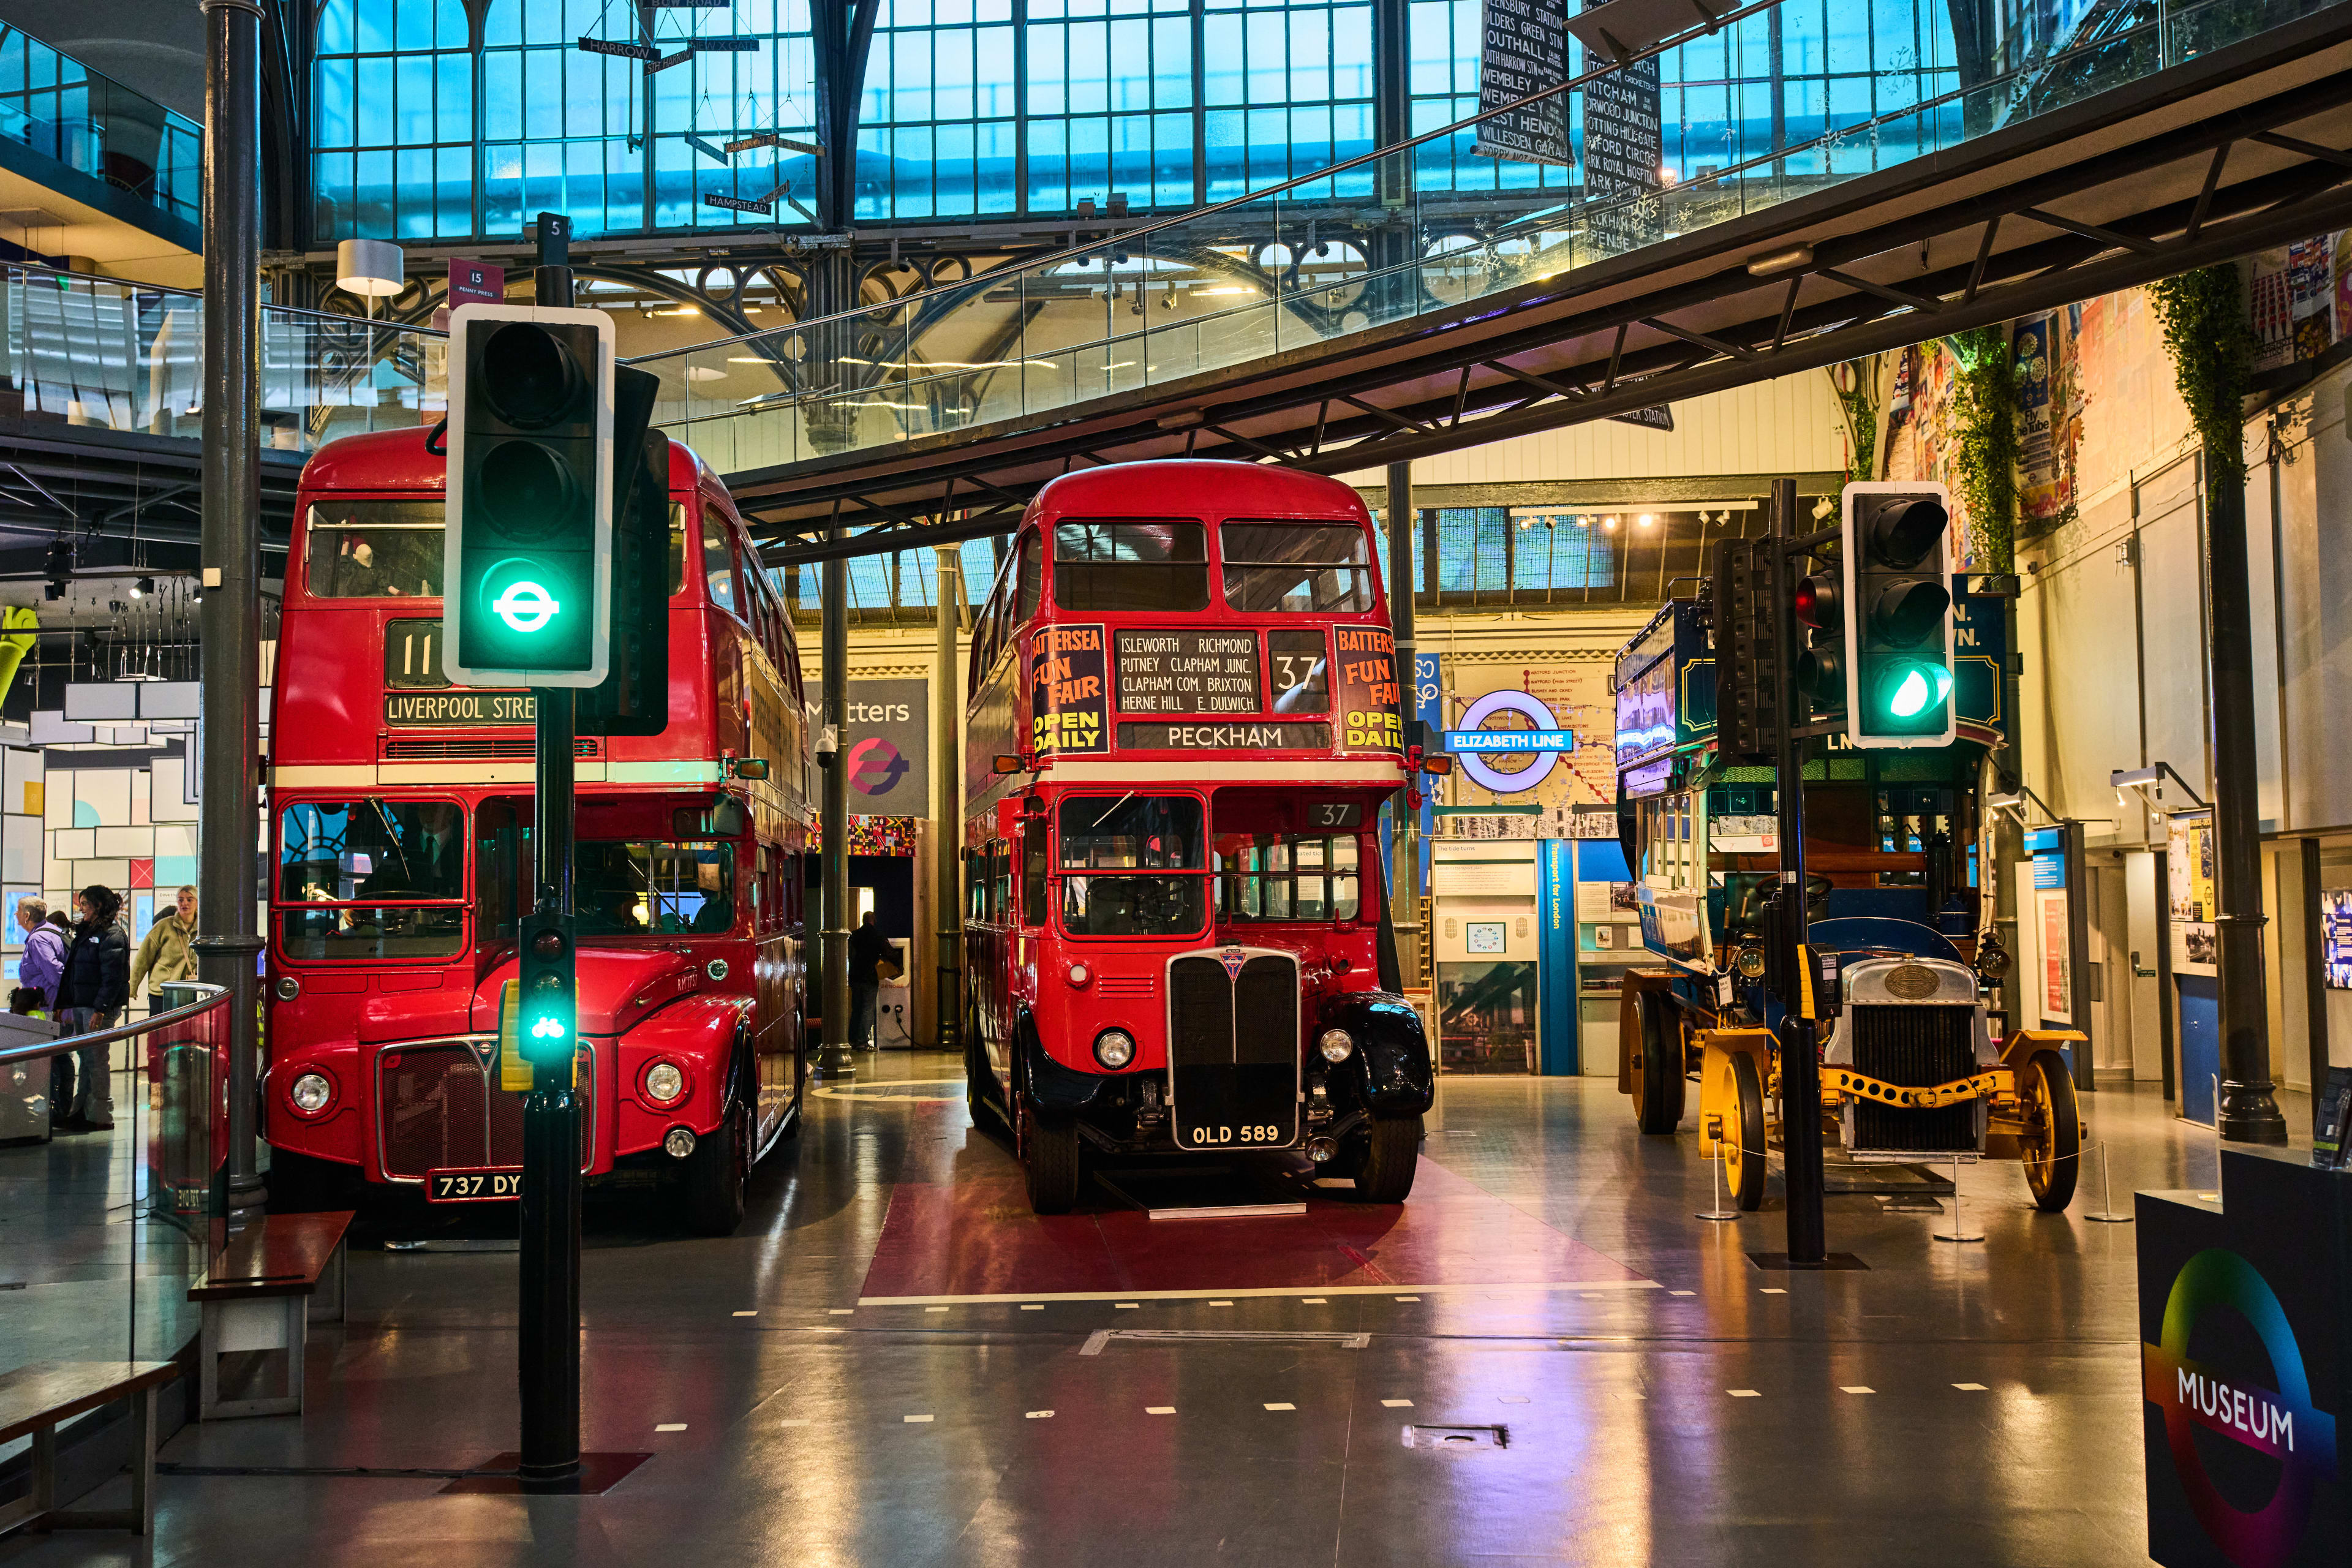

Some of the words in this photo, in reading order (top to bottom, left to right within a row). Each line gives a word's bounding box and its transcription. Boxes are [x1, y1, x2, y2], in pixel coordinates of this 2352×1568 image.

[1536, 7, 1562, 31] STATION
[1521, 21, 1545, 42] GREEN
[1550, 32, 1562, 50] STN
[590, 40, 649, 59] HARROW
[647, 62, 661, 74] STH
[662, 50, 691, 69] HARROW
[1501, 53, 1526, 72] HARROW
[1527, 61, 1538, 76] STN
[1482, 67, 1531, 92] WEMBLEY
[1624, 74, 1656, 91] CRICKETERS
[1521, 116, 1565, 141] HENDON
[1623, 108, 1658, 131] JUNCTION
[1482, 125, 1531, 150] WILLESDEN
[1620, 125, 1637, 143] HILL
[1638, 132, 1657, 149] GATE
[1604, 157, 1626, 176] ROYAL
[1627, 164, 1659, 186] HOSPITAL
[710, 195, 767, 213] HAMPSTEAD
[551, 221, 560, 236] 5
[472, 273, 481, 283] 15
[459, 286, 477, 295] PENNY
[478, 288, 494, 298] PRESS
[1644, 408, 1668, 426] STATION
[2025, 409, 2038, 423] Fly
[2028, 420, 2049, 434] Tube
[1032, 630, 1101, 662] BATTERSEA
[1121, 638, 1179, 653] ISLEWORTH
[1199, 638, 1252, 654] RICHMOND
[1338, 630, 1395, 656] BATTERS
[1953, 628, 1981, 646] N.
[404, 634, 431, 674] 11
[1121, 657, 1159, 673] PUTNEY
[1170, 657, 1219, 673] CLAPHAM
[1224, 658, 1251, 673] JUNC.
[1033, 657, 1072, 693] FUN
[1276, 657, 1317, 690] 37
[1344, 659, 1391, 685] FUN
[1047, 676, 1102, 708] FAIR
[1122, 677, 1172, 692] CLAPHAM
[1177, 677, 1201, 692] COM.
[1207, 677, 1251, 693] BRIXTON
[1369, 682, 1400, 706] FAI
[388, 697, 484, 718] LIVERPOOL
[492, 697, 535, 718] STRE
[805, 701, 910, 723] Mtters
[1122, 696, 1156, 710] HERNE
[1161, 696, 1183, 710] HILL
[1197, 697, 1206, 710] E.
[1211, 697, 1254, 711] DULWICH
[1034, 712, 1099, 734] OPEN
[1034, 730, 1101, 754] DAILY
[1169, 727, 1281, 747] PECKHAM
[1454, 735, 1528, 747] ELIZABETH
[1532, 734, 1564, 747] LINE
[701, 810, 714, 832] 11
[1322, 804, 1349, 825] 37
[1550, 843, 1560, 883] Transport
[677, 978, 686, 992] RM
[1193, 1126, 1232, 1144] OLD
[1240, 1125, 1278, 1142] 589
[440, 1177, 484, 1196] 737
[494, 1175, 521, 1193] DY
[2178, 1366, 2294, 1452] MUSEUM
